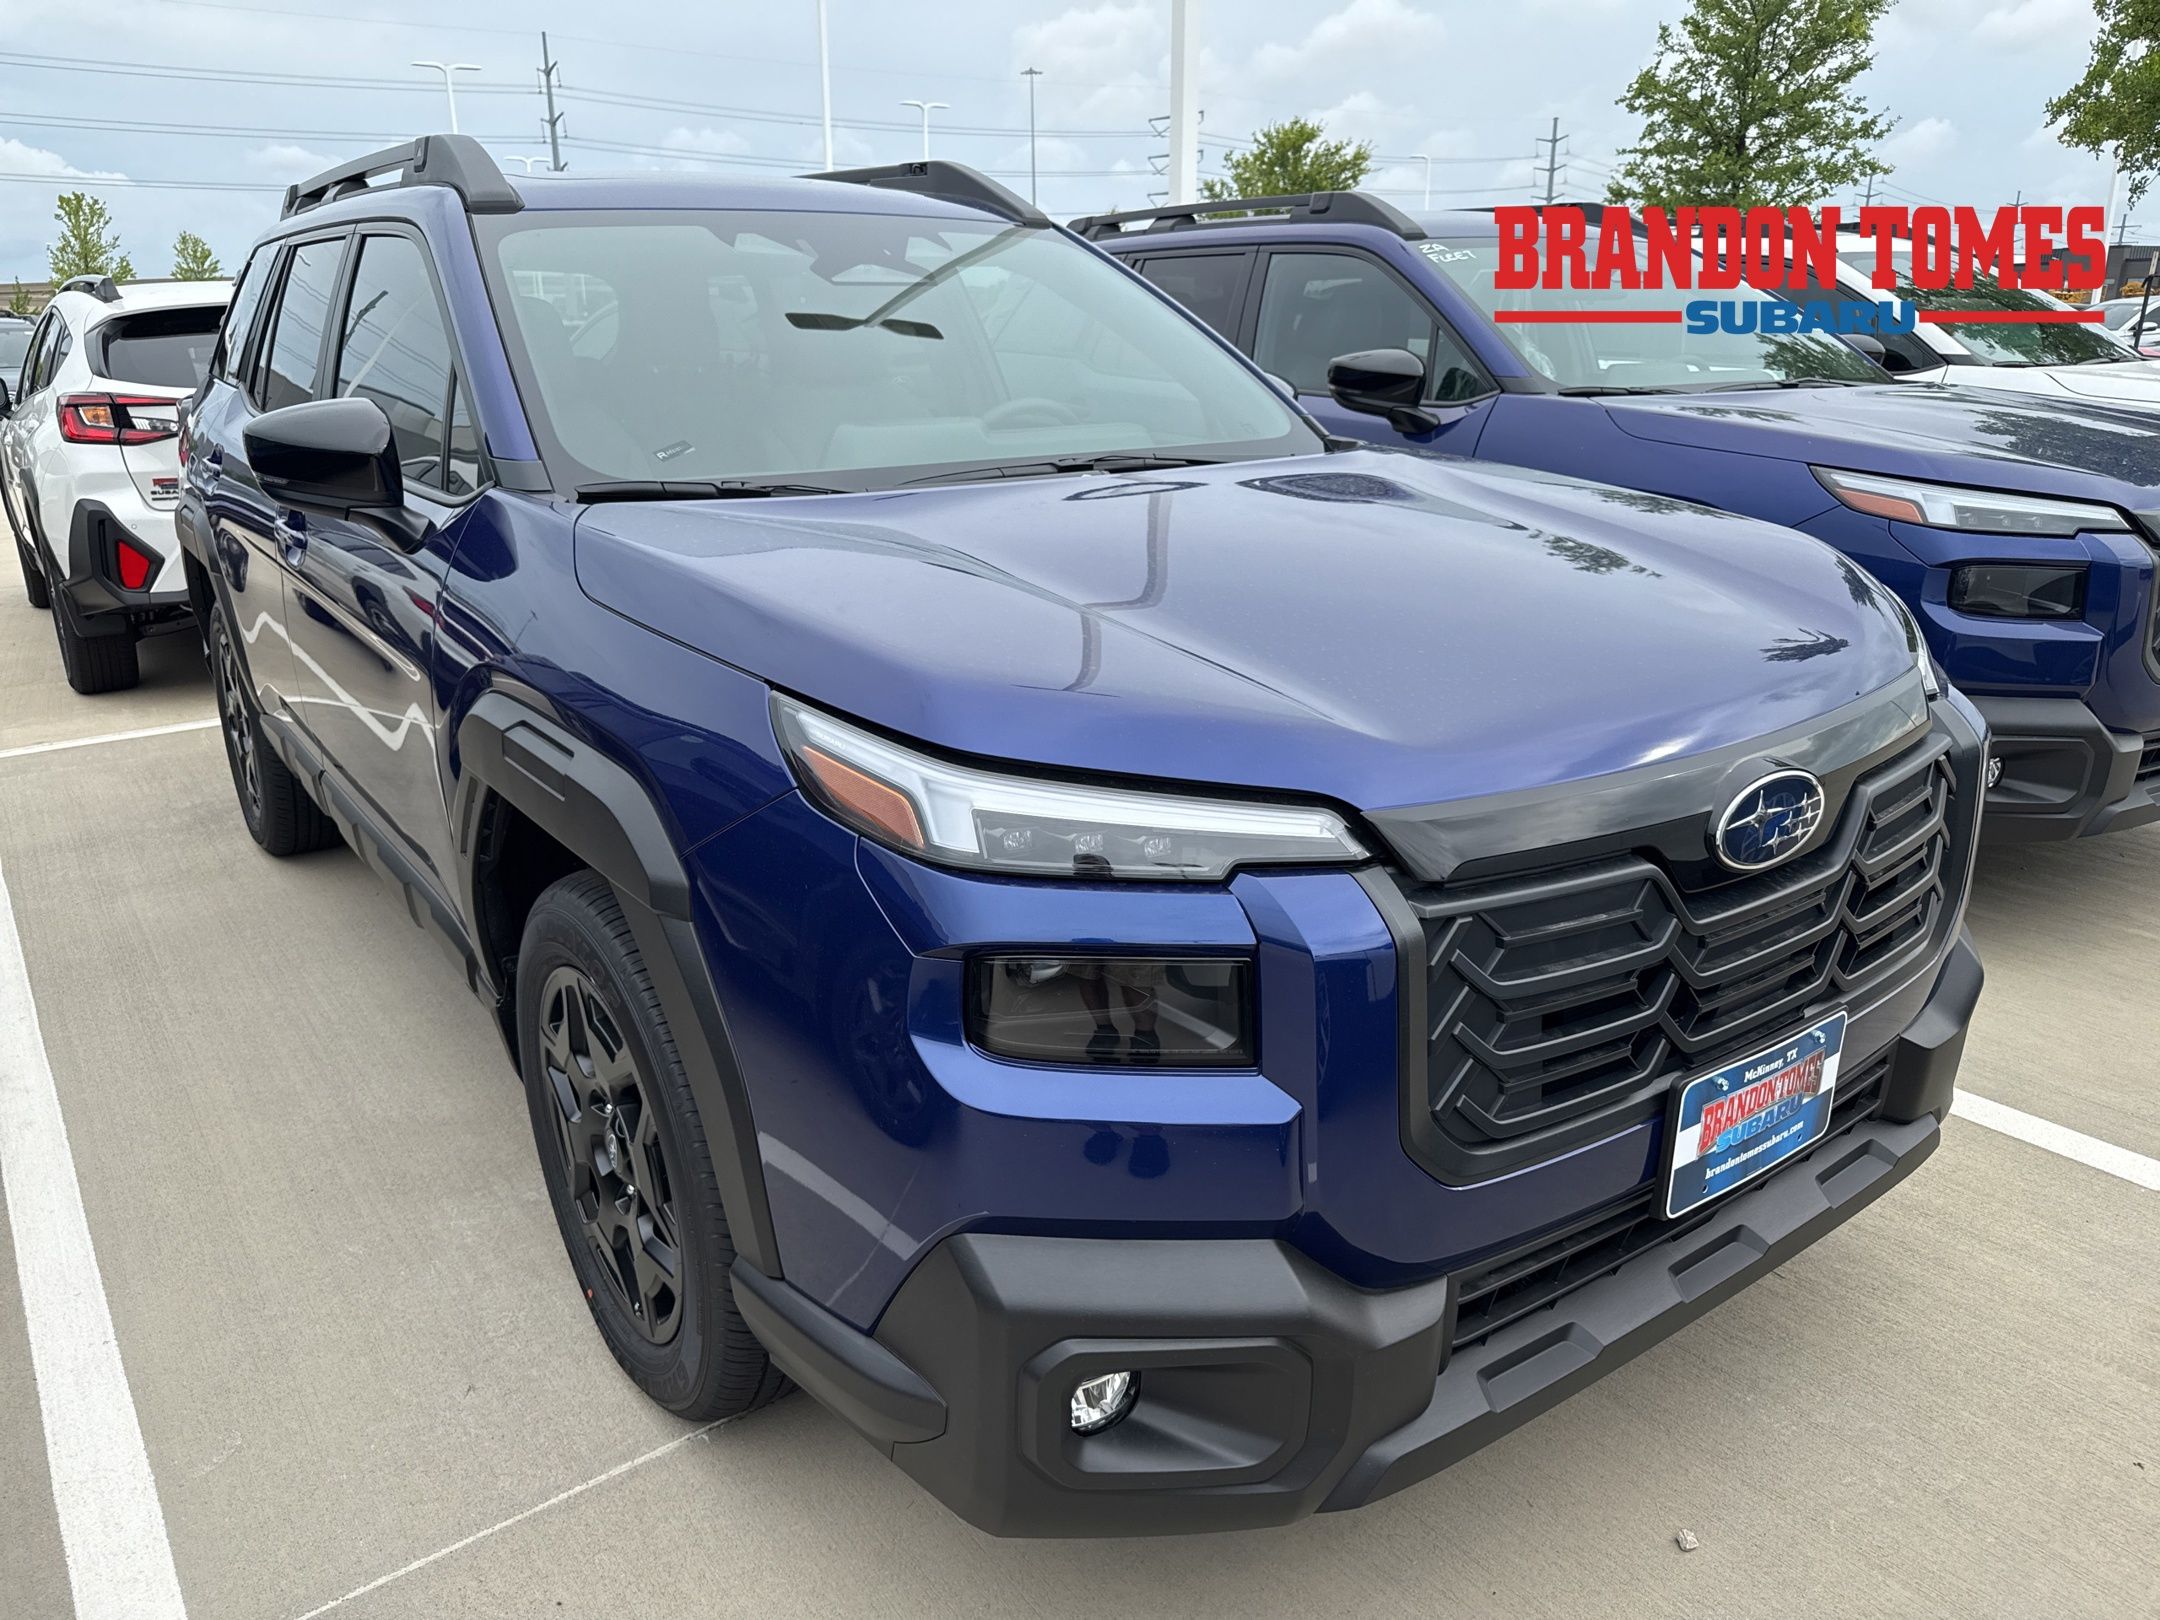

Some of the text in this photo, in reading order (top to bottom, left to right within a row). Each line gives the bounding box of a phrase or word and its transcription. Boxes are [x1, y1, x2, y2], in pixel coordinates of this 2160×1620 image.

[1744, 1047, 1798, 1083] McKinney, TX
[1697, 1050, 1825, 1155] BRANDON TOMES
[1715, 1094, 1803, 1153] SUBARU
[1705, 1121, 1804, 1180] brandontomessubaru.com
